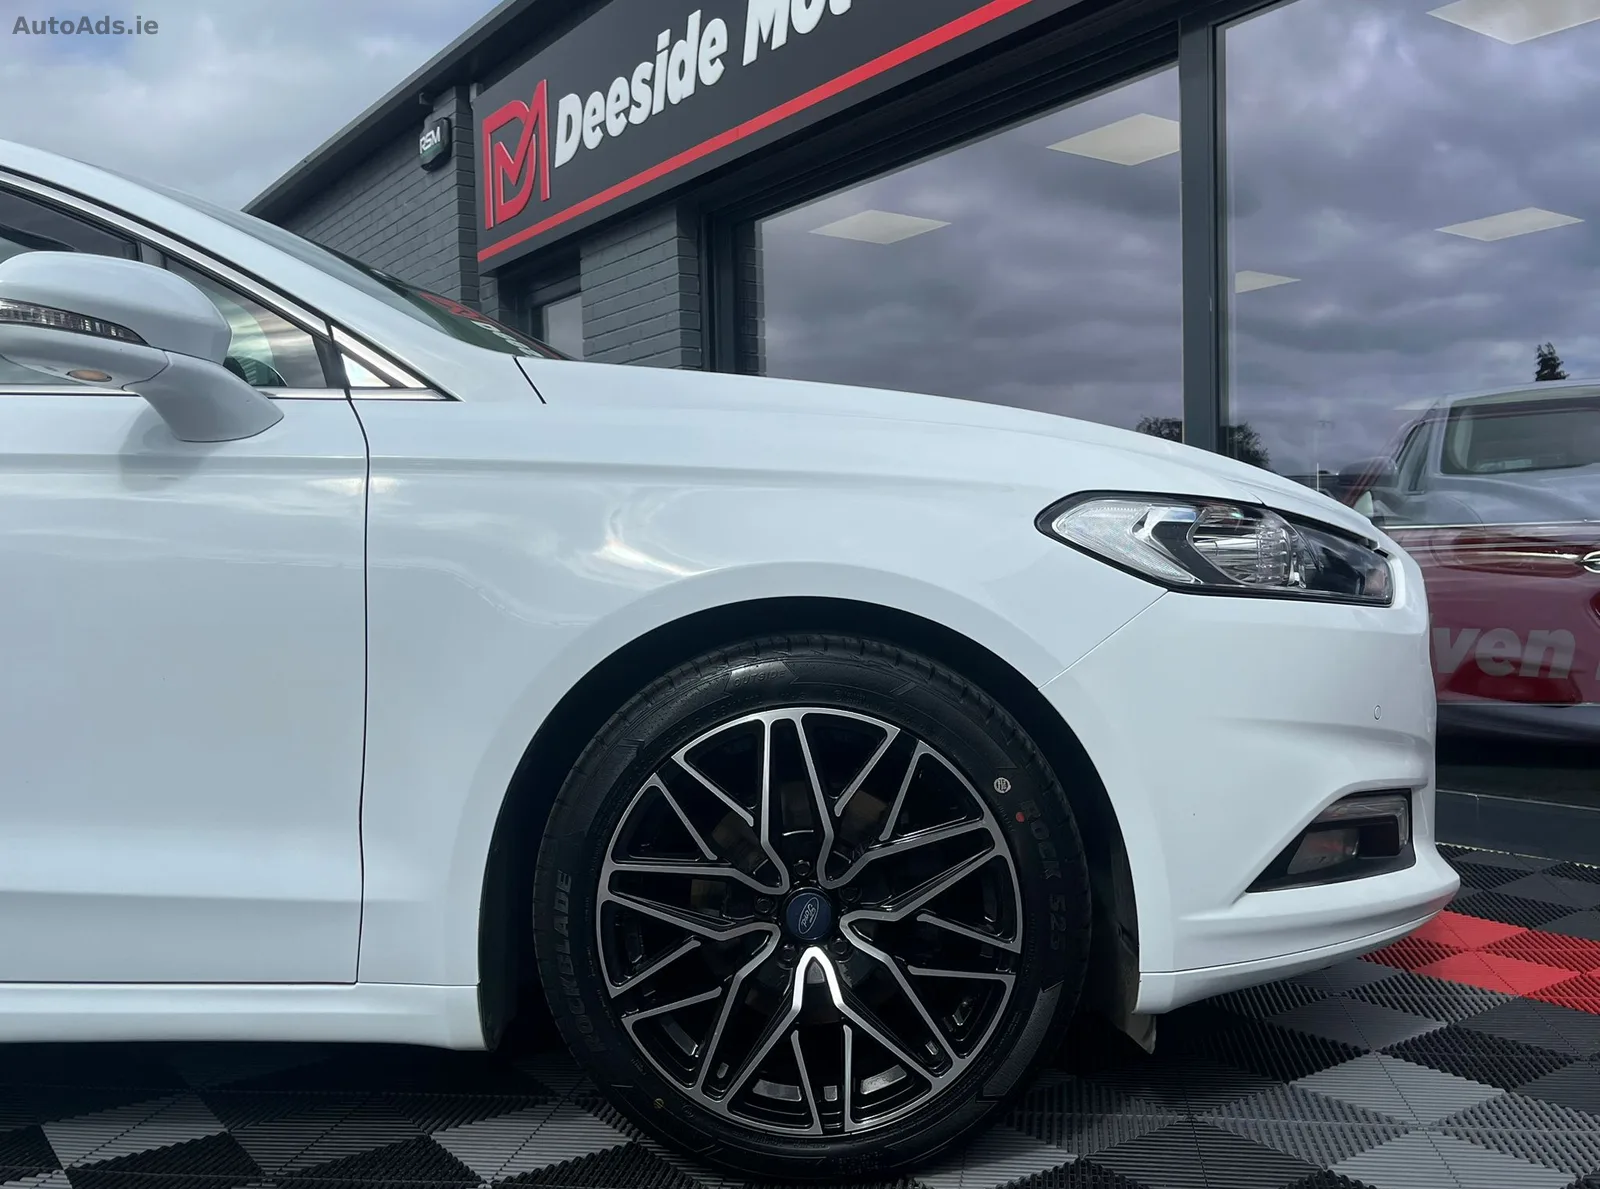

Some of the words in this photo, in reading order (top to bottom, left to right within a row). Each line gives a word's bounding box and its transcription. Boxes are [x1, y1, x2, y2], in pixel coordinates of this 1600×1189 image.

[554, 9, 728, 169] Deeside
[419, 126, 441, 155] RSM
[1432, 627, 1577, 680] ven
[733, 667, 787, 689] OUTSIDE
[1019, 798, 1063, 880] ROCK
[1049, 893, 1067, 951] 525
[800, 902, 817, 929] Ford
